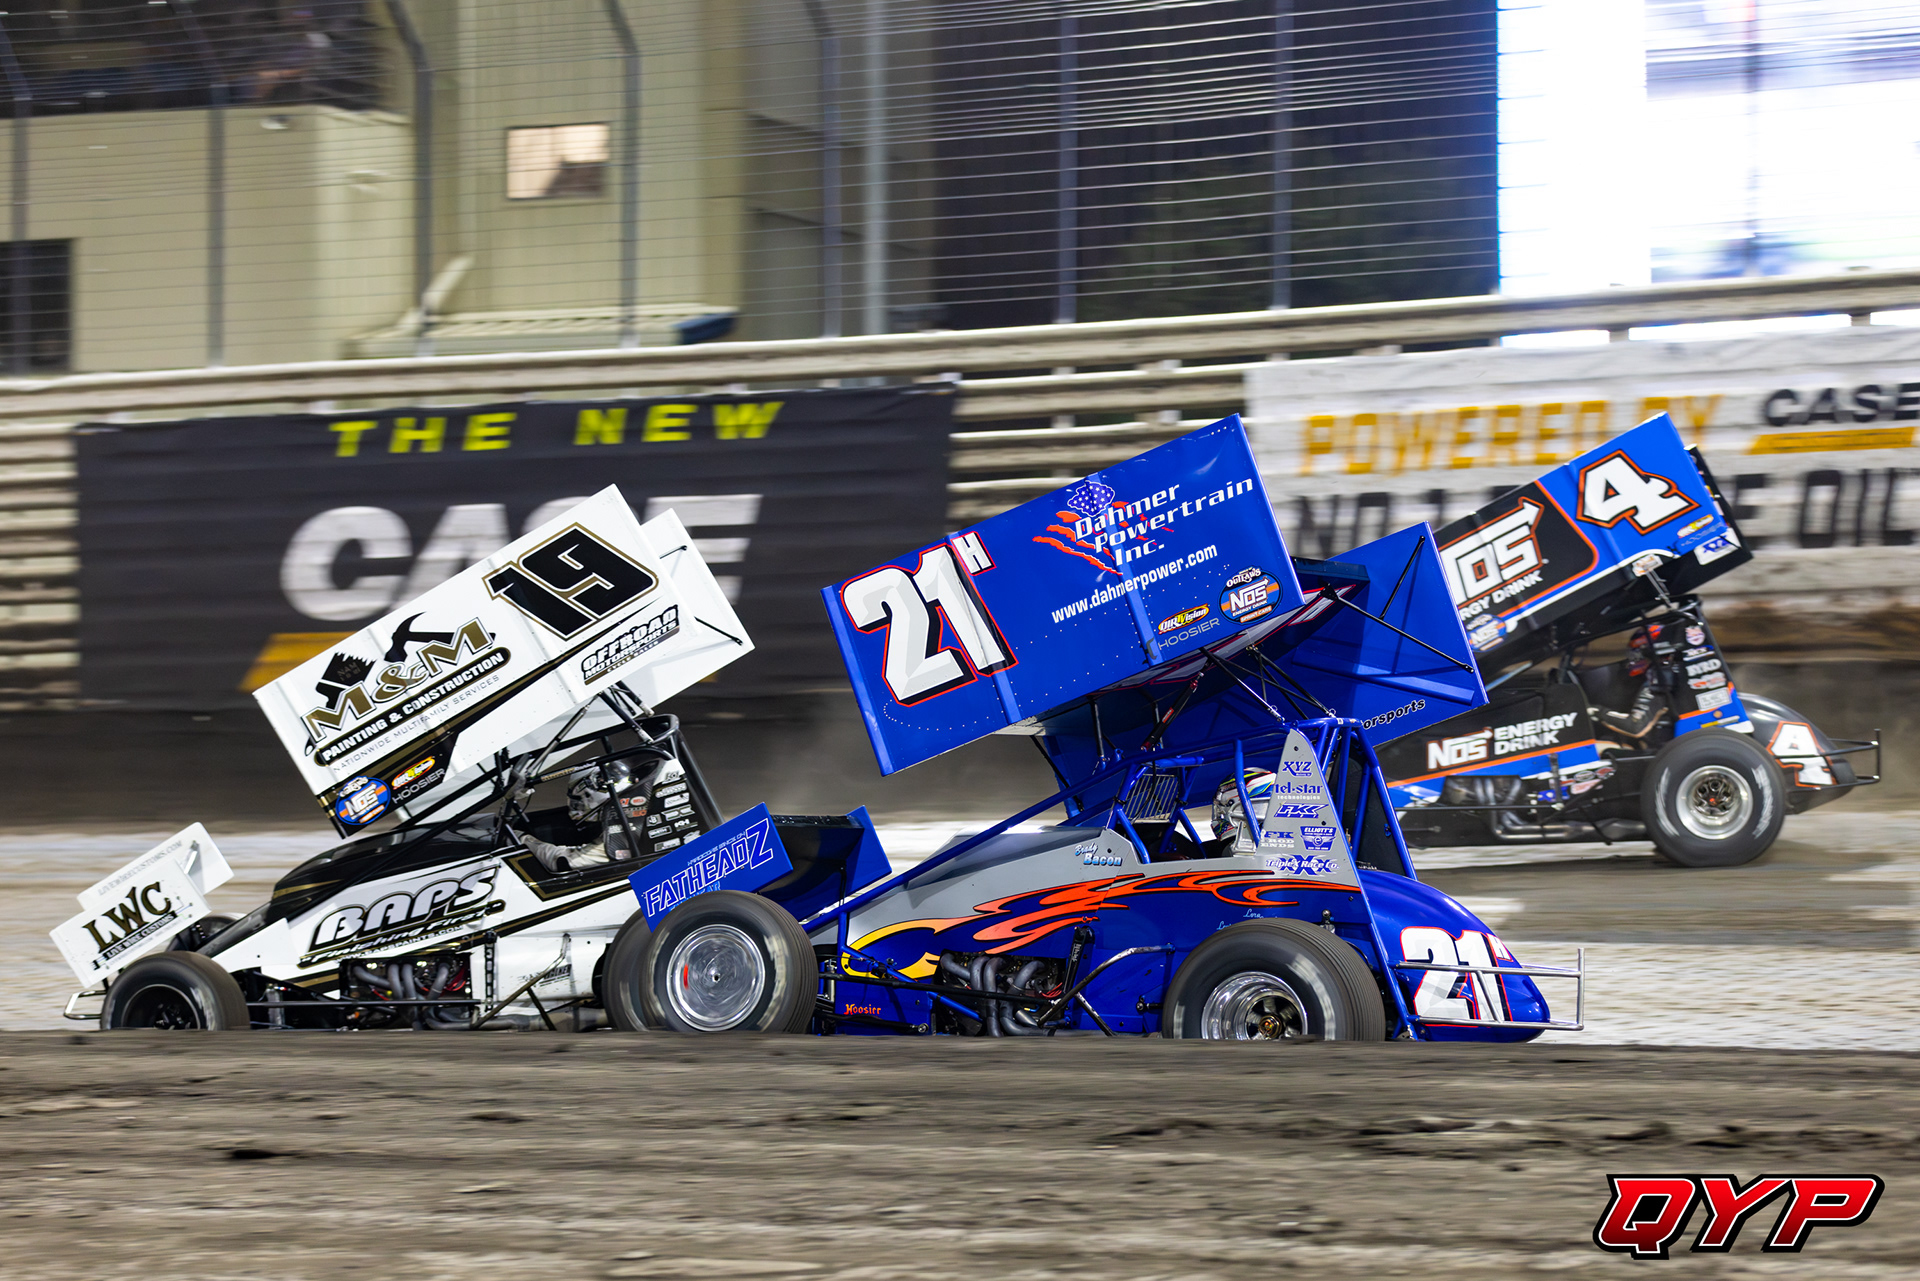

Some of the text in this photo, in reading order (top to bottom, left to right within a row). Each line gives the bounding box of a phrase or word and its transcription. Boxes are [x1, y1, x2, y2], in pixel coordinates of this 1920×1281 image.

[329, 401, 785, 458] THE NEW
[1762, 383, 1920, 426] CASE
[1297, 399, 1611, 474] POWERED
[1074, 484, 1181, 541] Dahmer
[1094, 477, 1254, 553] Powertrain
[1578, 451, 1699, 534] 4
[1799, 467, 1919, 549] OIL
[279, 493, 764, 622] CAE
[482, 522, 659, 642] 19
[1114, 539, 1165, 566] Inc.
[1051, 543, 1218, 624] www.dahmerpower.com
[1229, 577, 1269, 613] NOS
[1459, 596, 1491, 622] RGY
[1491, 570, 1543, 604] DRINK
[582, 606, 678, 671] OFFROAD
[584, 621, 677, 679] MOTORSPORTS
[1158, 617, 1220, 650] HOOSIER
[301, 617, 493, 742] M&M
[322, 651, 505, 762] PAINTING & CONSTRUCTION
[333, 674, 500, 772] NATIONWIDE MULTIFAMILY SERVICES
[1362, 699, 1426, 730] orsports
[1427, 712, 1577, 772] NOS ENERGY
[1494, 730, 1559, 756] DRINK
[1282, 761, 1312, 774] XYZ
[1767, 721, 1836, 788] 4
[344, 782, 378, 818] NOS
[391, 768, 446, 804] HOOSIER
[645, 817, 774, 918] FATHEADZ
[1083, 853, 1122, 867] Bacon
[1301, 859, 1324, 869] Race
[82, 881, 172, 954] LWC
[141, 913, 175, 936] CUSTOMS
[313, 866, 500, 946] BAPS
